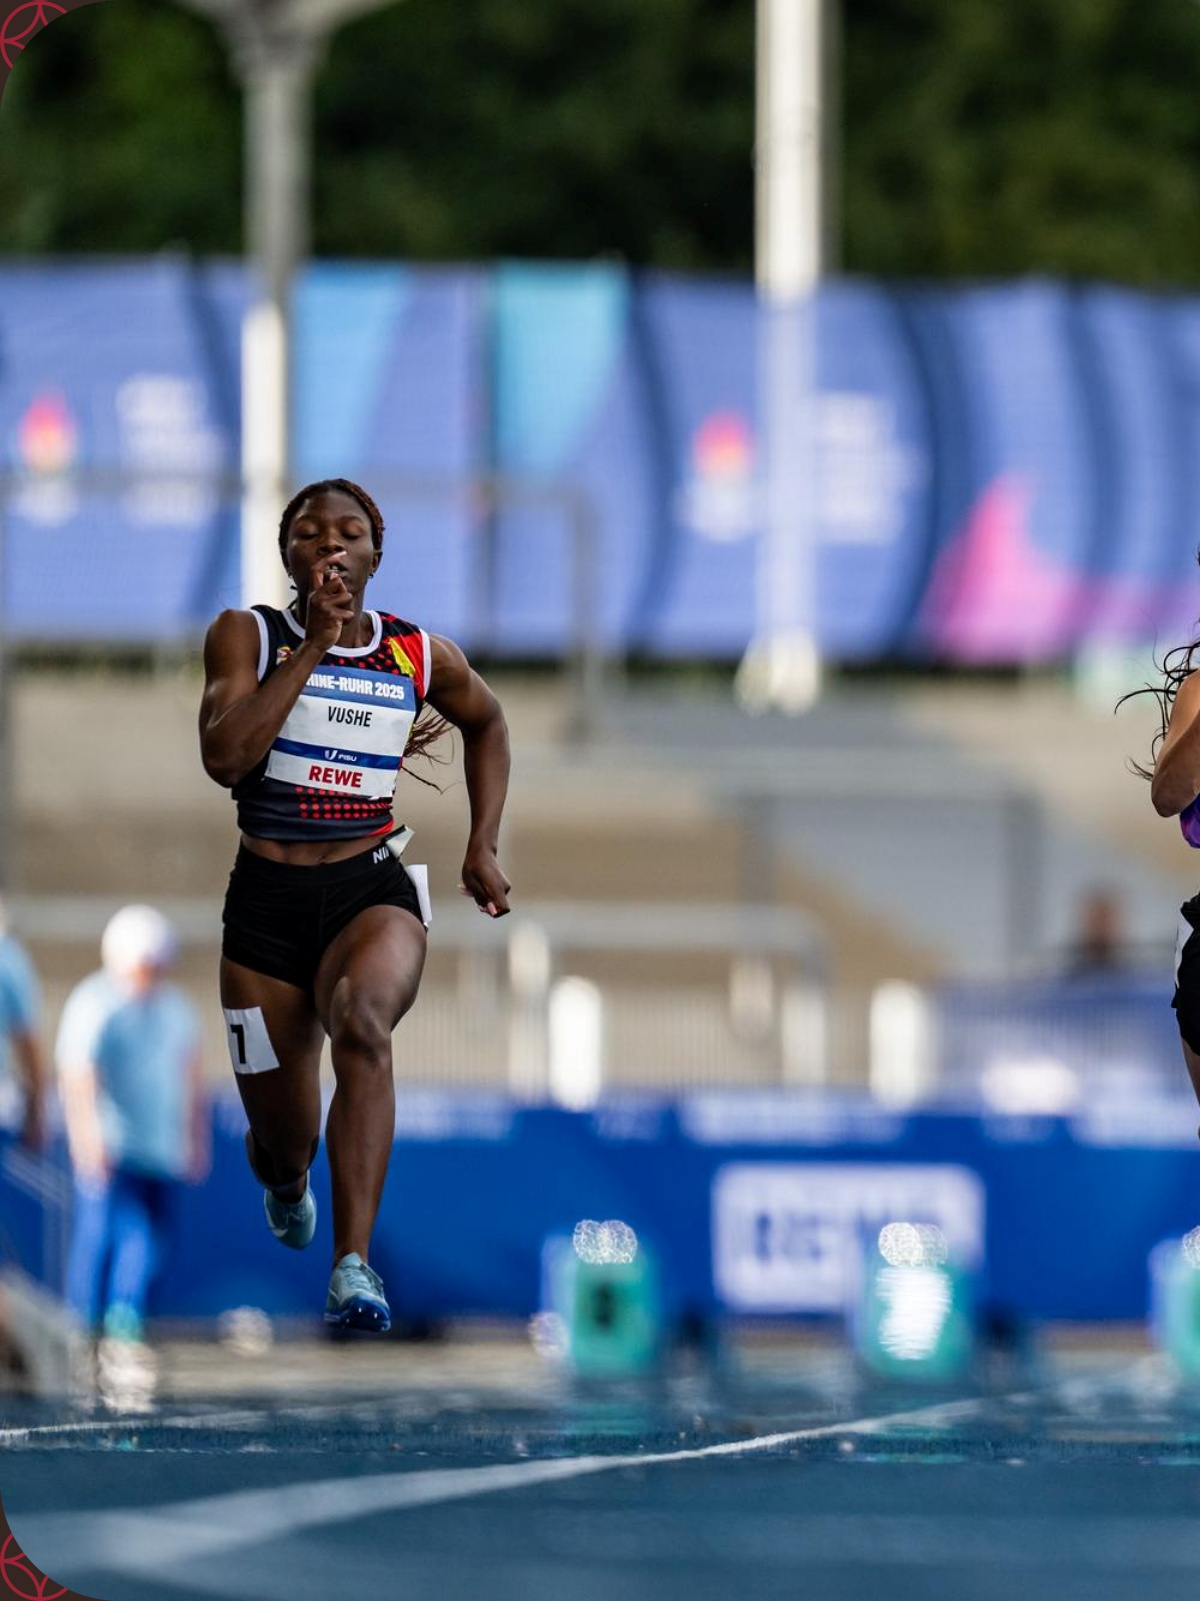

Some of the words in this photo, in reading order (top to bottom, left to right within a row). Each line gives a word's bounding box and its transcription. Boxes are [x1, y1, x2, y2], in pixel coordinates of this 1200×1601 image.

[305, 673, 374, 696] HINE-RUHR
[375, 682, 405, 700] 2025
[328, 706, 373, 727] VUSHE
[308, 765, 363, 788] REWE
